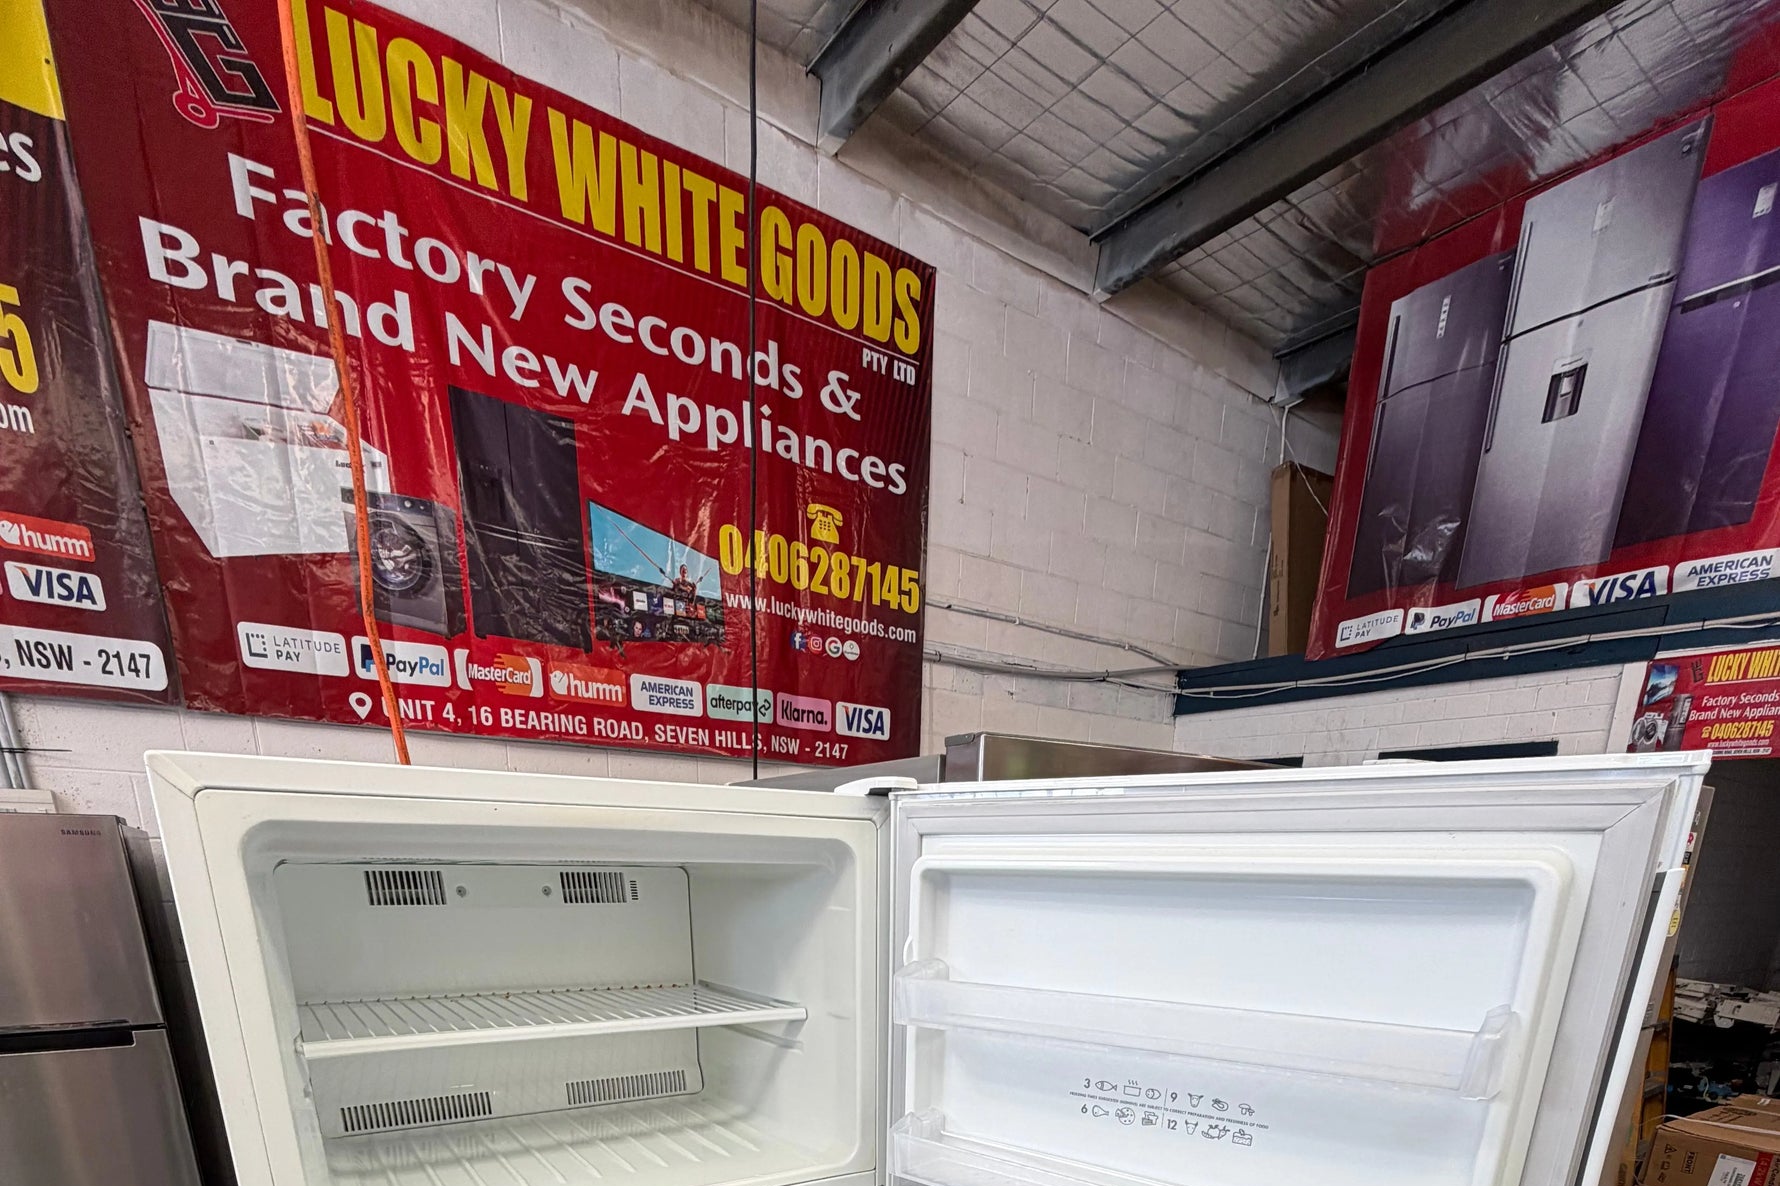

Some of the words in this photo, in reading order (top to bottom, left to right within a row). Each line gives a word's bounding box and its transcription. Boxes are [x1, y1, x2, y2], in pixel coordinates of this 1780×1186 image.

[291, 0, 533, 202] LUCKY
[547, 106, 749, 288] WHITE
[760, 206, 922, 356] GOODS
[227, 152, 537, 322] Factory
[561, 276, 804, 400] Seconds
[819, 369, 861, 422] &
[138, 215, 416, 353] Brand
[445, 311, 600, 404] New
[621, 372, 908, 496] Appliances
[861, 347, 888, 376] PTY
[893, 360, 916, 386] LTD
[20, 523, 91, 558] humm
[718, 523, 920, 615] 0406287145
[1686, 554, 1773, 578] AMERICAN
[1696, 567, 1771, 588] EXPRESS
[14, 565, 98, 606] VISA
[1587, 570, 1657, 605] VISA
[725, 592, 917, 644] www.luckywhitegoods.com
[1492, 594, 1555, 618] MasterCard
[1355, 614, 1399, 631] LATITUDE
[1429, 607, 1476, 630] PayPal
[273, 635, 342, 655] LATITUDE
[1353, 628, 1372, 639] PAY
[14, 638, 75, 672] NSW
[97, 648, 152, 680] 2147
[276, 649, 301, 663] PAY
[385, 652, 446, 678] PayPal
[1706, 652, 1752, 683] LUCKY
[468, 662, 532, 686] MasterCard
[569, 672, 623, 703] humm
[640, 680, 694, 698] AMERICAN
[1701, 695, 1739, 708] Factory
[1739, 689, 1780, 704] Seconds
[648, 695, 695, 711] EXPRESS
[710, 692, 759, 716] afterpa
[1688, 707, 1718, 721] Brand
[1719, 708, 1741, 719] New
[381, 695, 436, 721] NIT
[442, 702, 462, 727] 4,
[468, 705, 493, 727] 16
[500, 707, 588, 736] BEARING
[593, 717, 649, 743] ROAD,
[654, 723, 710, 746] SEVEN
[715, 729, 768, 754] HILLS,
[771, 735, 800, 755] NSW
[814, 741, 849, 760] 2147
[841, 704, 886, 737] VISA
[1710, 720, 1775, 740] 0406287145
[60, 829, 102, 837] SAMSUNG
[1083, 1077, 1091, 1089] 3
[1080, 1103, 1088, 1114] 6
[1170, 1091, 1178, 1103] 9
[1167, 1118, 1178, 1131] 12
[1683, 1151, 1696, 1173] FRONT
